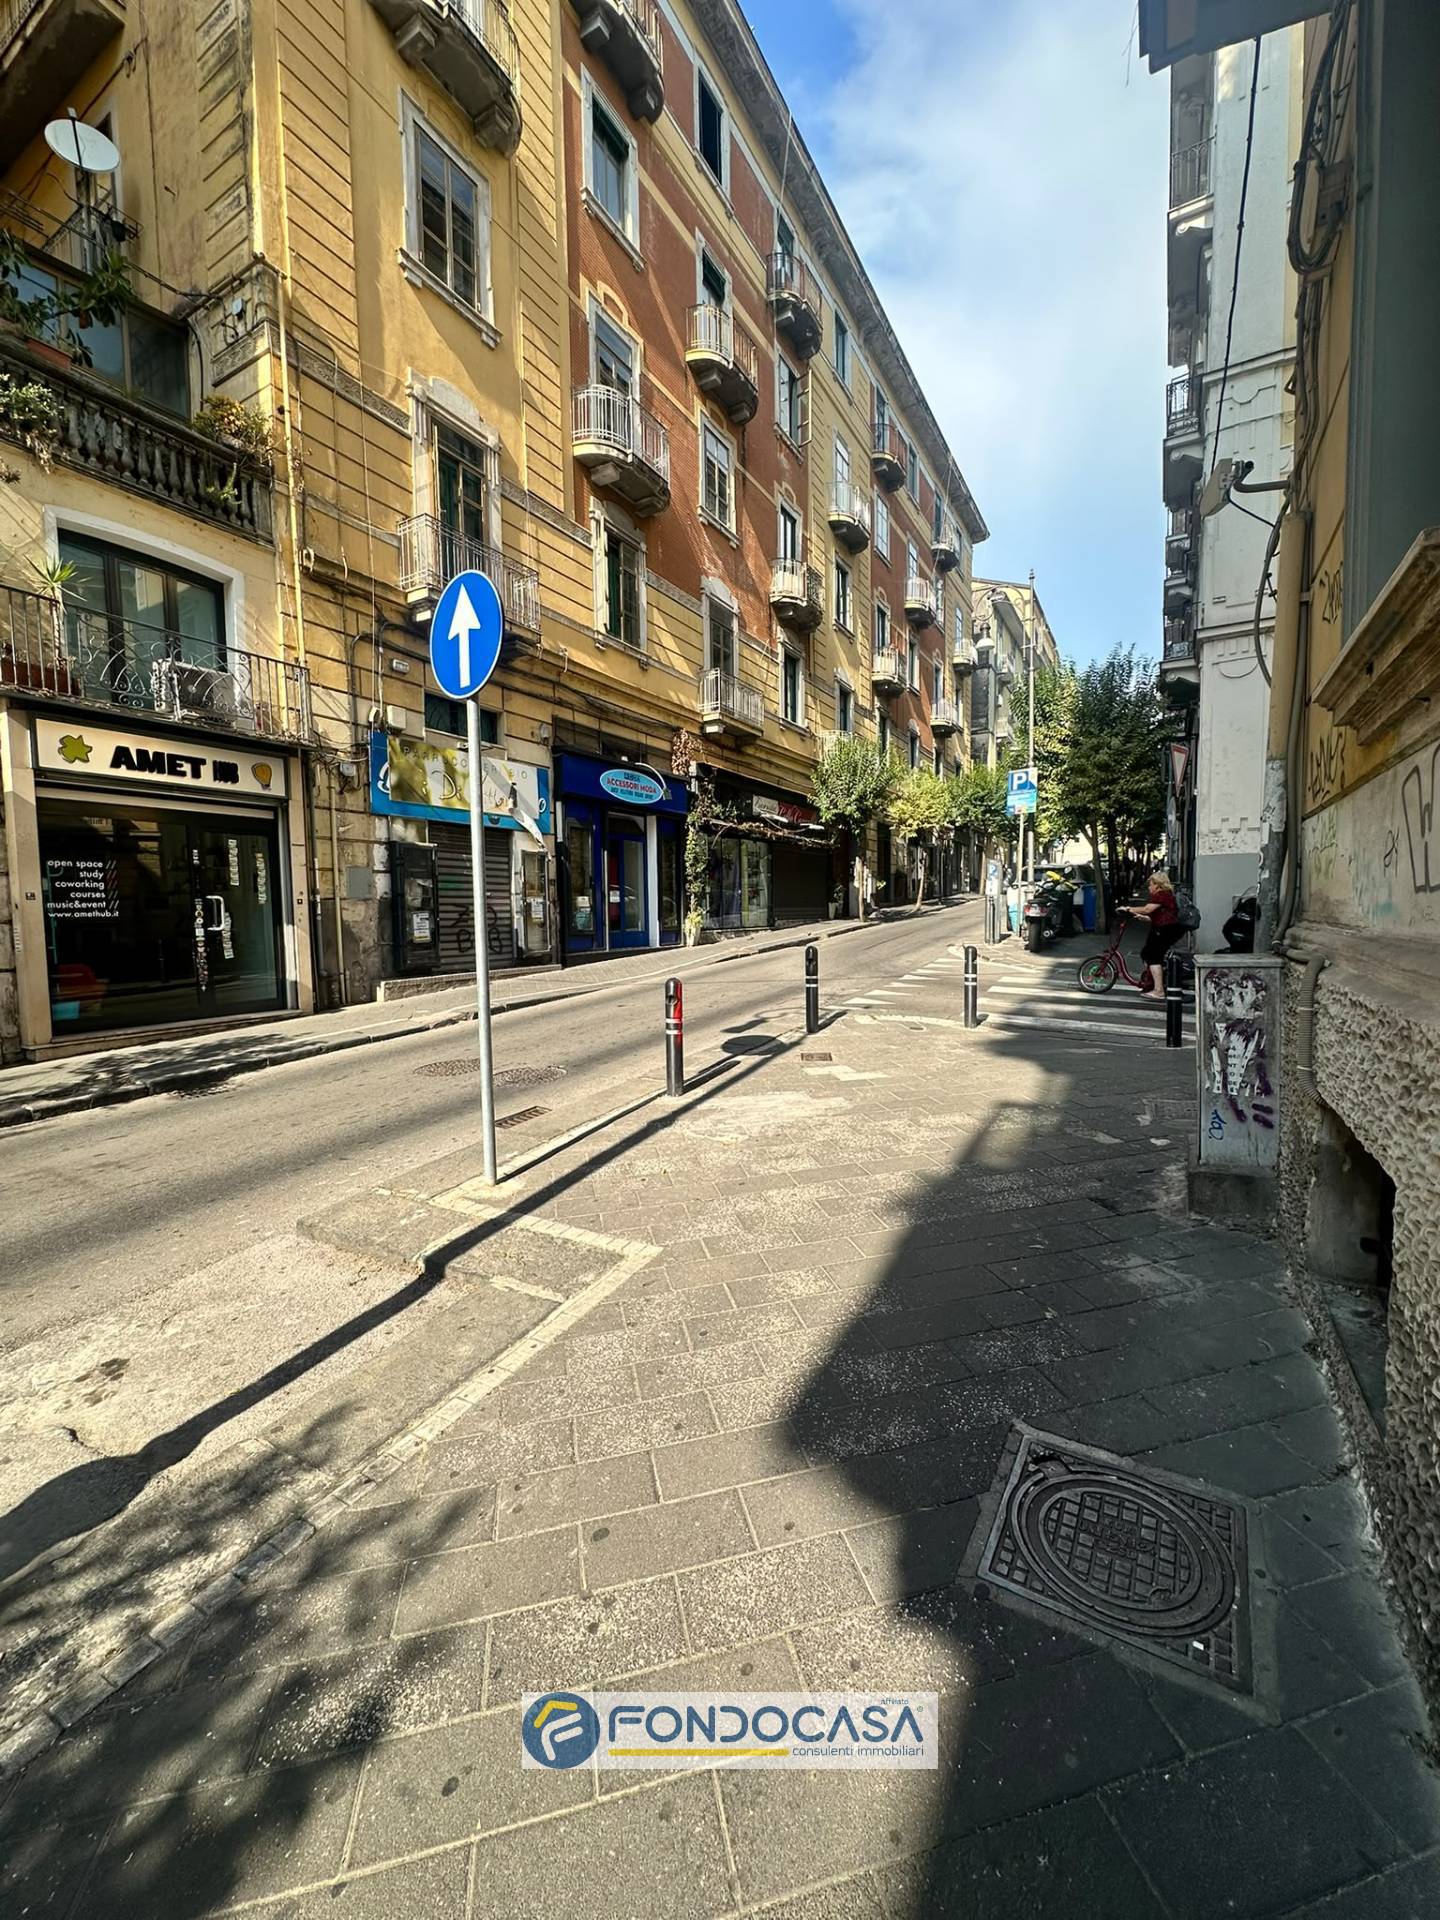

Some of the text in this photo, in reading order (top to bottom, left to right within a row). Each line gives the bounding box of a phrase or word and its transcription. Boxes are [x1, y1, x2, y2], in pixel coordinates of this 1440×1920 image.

[110, 745, 207, 779] AMET
[1012, 771, 1027, 790] P
[47, 860, 103, 870] open space
[79, 869, 104, 880] study
[55, 879, 105, 891] coworking
[47, 900, 106, 909] music&event
